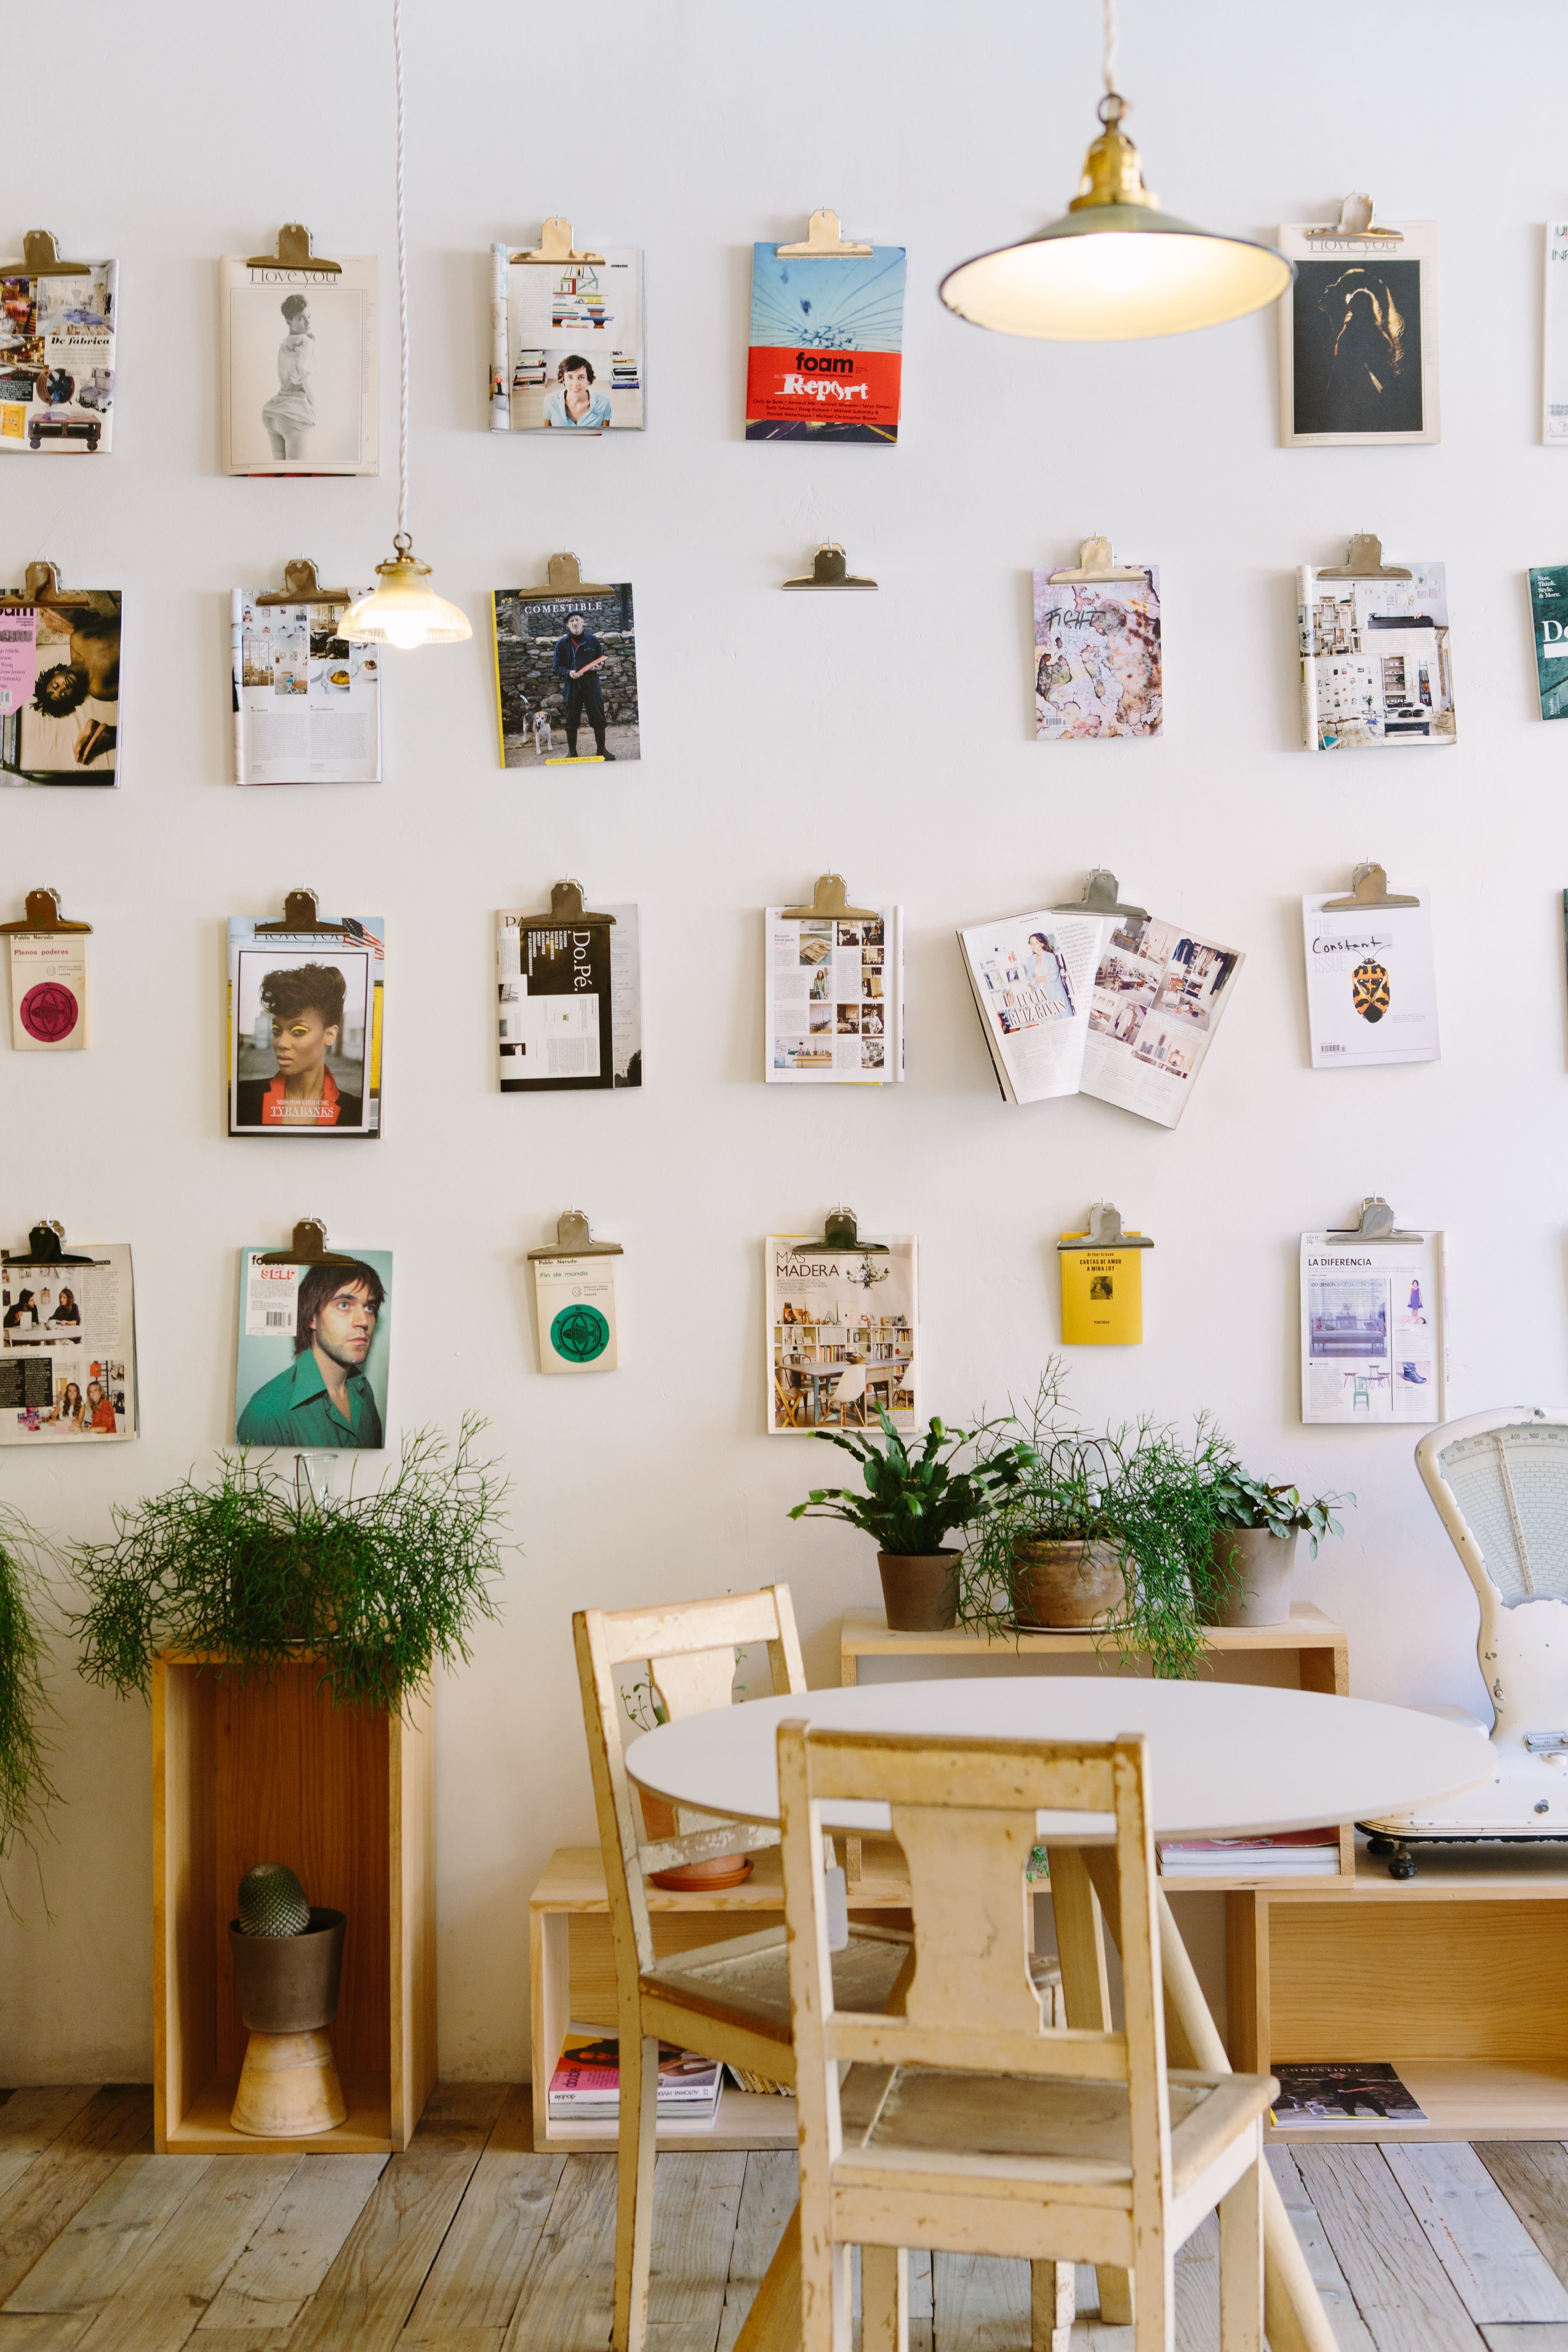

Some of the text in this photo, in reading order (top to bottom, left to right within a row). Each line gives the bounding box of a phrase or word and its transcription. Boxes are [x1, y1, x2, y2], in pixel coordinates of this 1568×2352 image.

[261, 269, 297, 282] love
[302, 271, 337, 288] you
[68, 337, 110, 346] fábrica
[796, 352, 854, 373] foam
[774, 374, 870, 401] Report
[524, 602, 603, 614] COMESTIBLE
[1044, 607, 1106, 631] FIGHT
[1311, 919, 1335, 935] THE
[1312, 936, 1382, 954] Constant
[1314, 955, 1347, 974] ISSUE
[270, 1106, 334, 1116] TYRA BANKS
[260, 1269, 296, 1280] SELF
[777, 1264, 840, 1277] MADERA
[1473, 1439, 1483, 1448] 200
